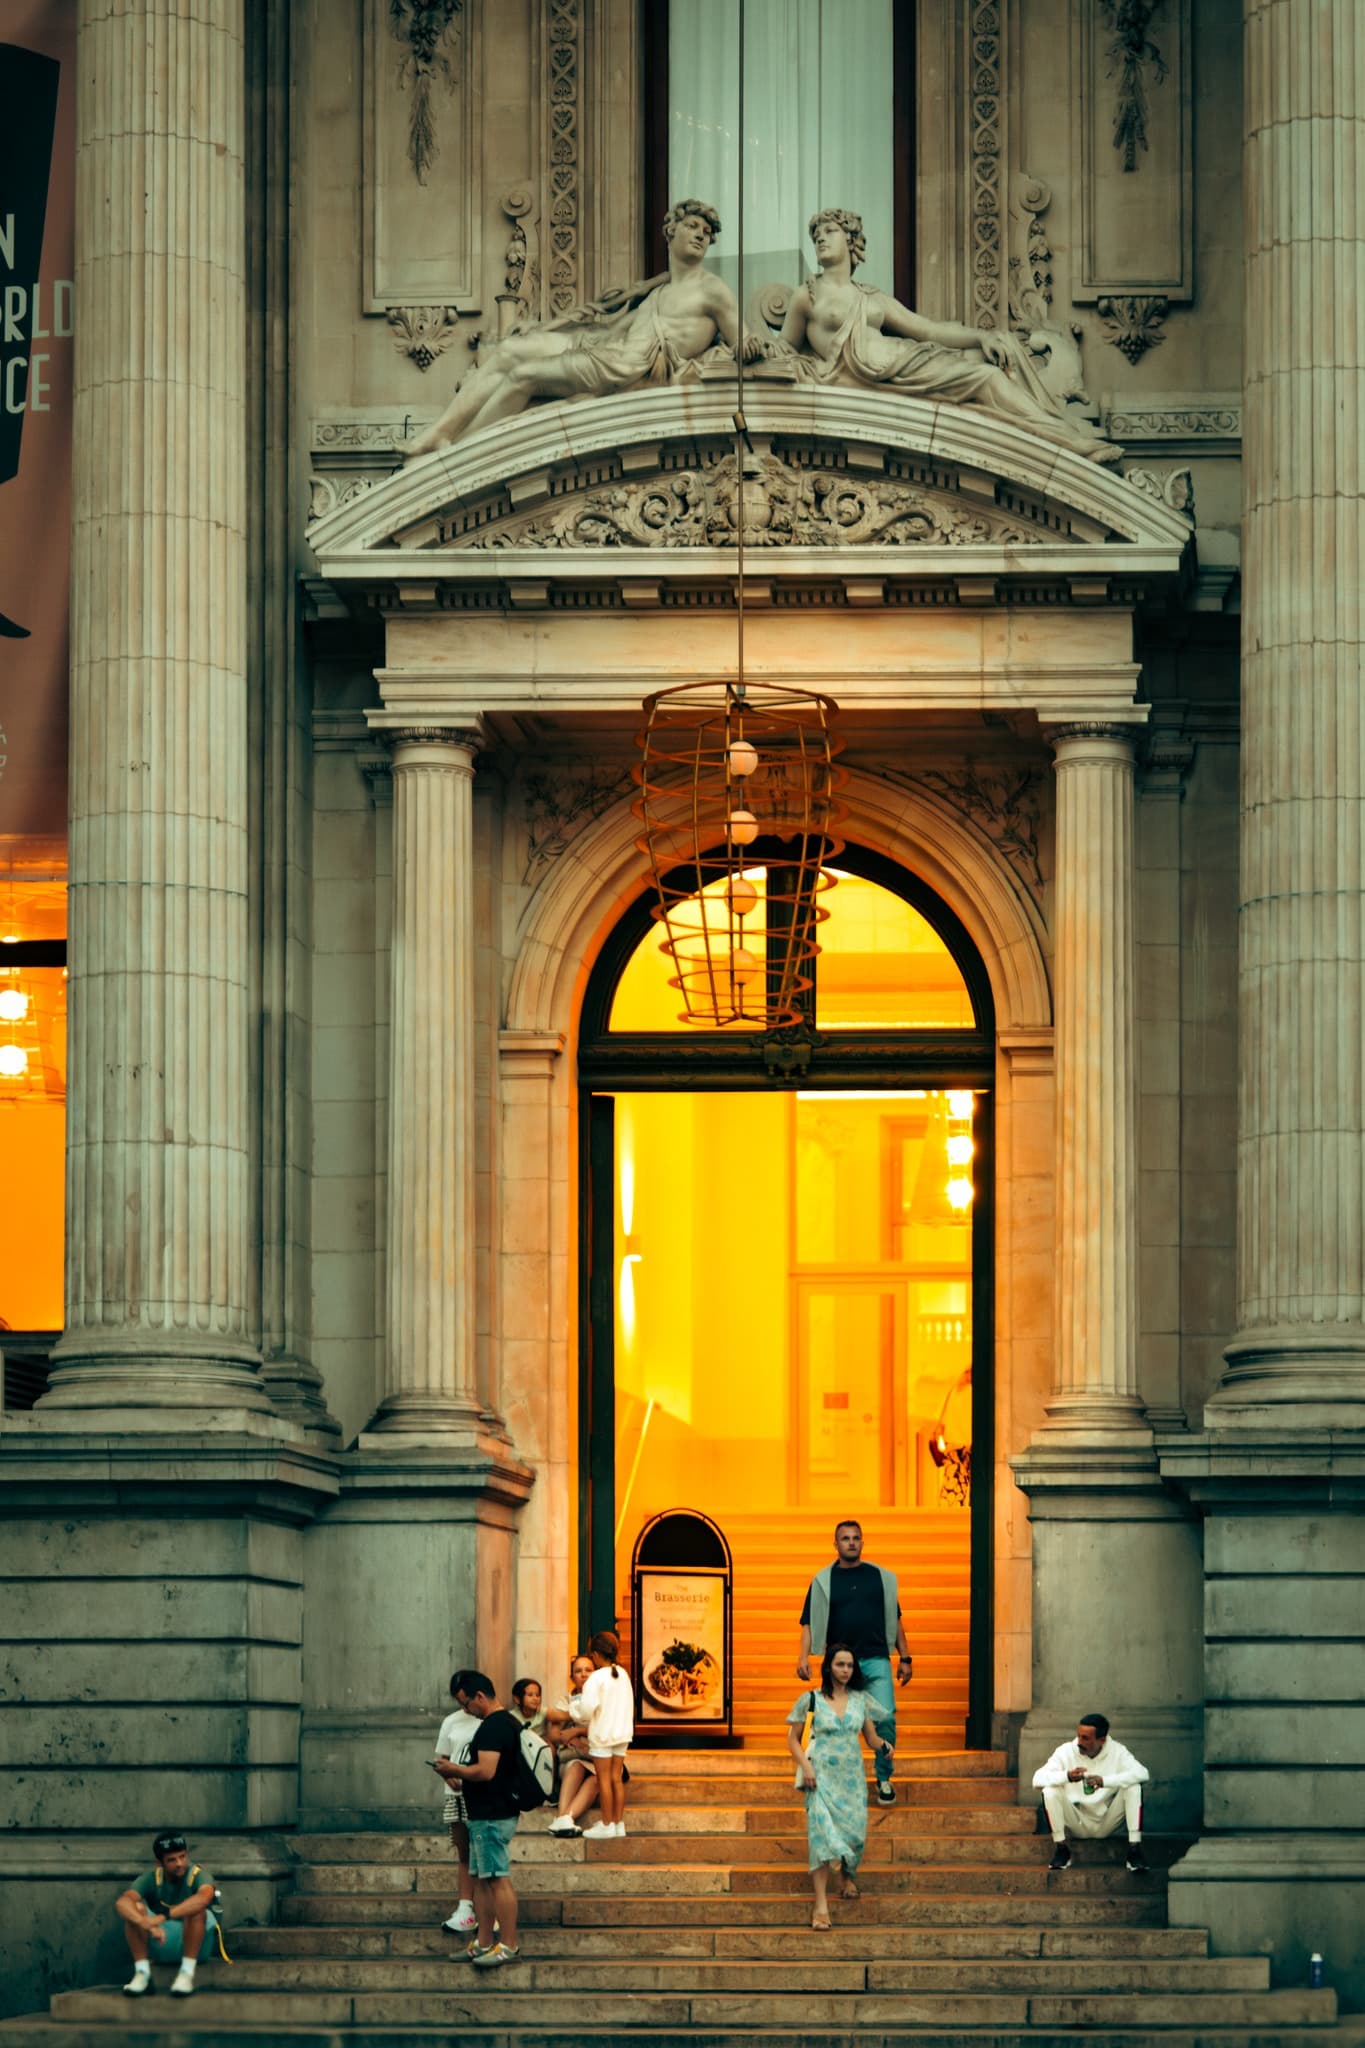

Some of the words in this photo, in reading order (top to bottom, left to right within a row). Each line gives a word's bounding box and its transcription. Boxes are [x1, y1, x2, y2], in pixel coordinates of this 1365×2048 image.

[0, 279, 75, 342] RLD
[0, 354, 50, 414] CE
[655, 1592, 710, 1603] Brasserie
